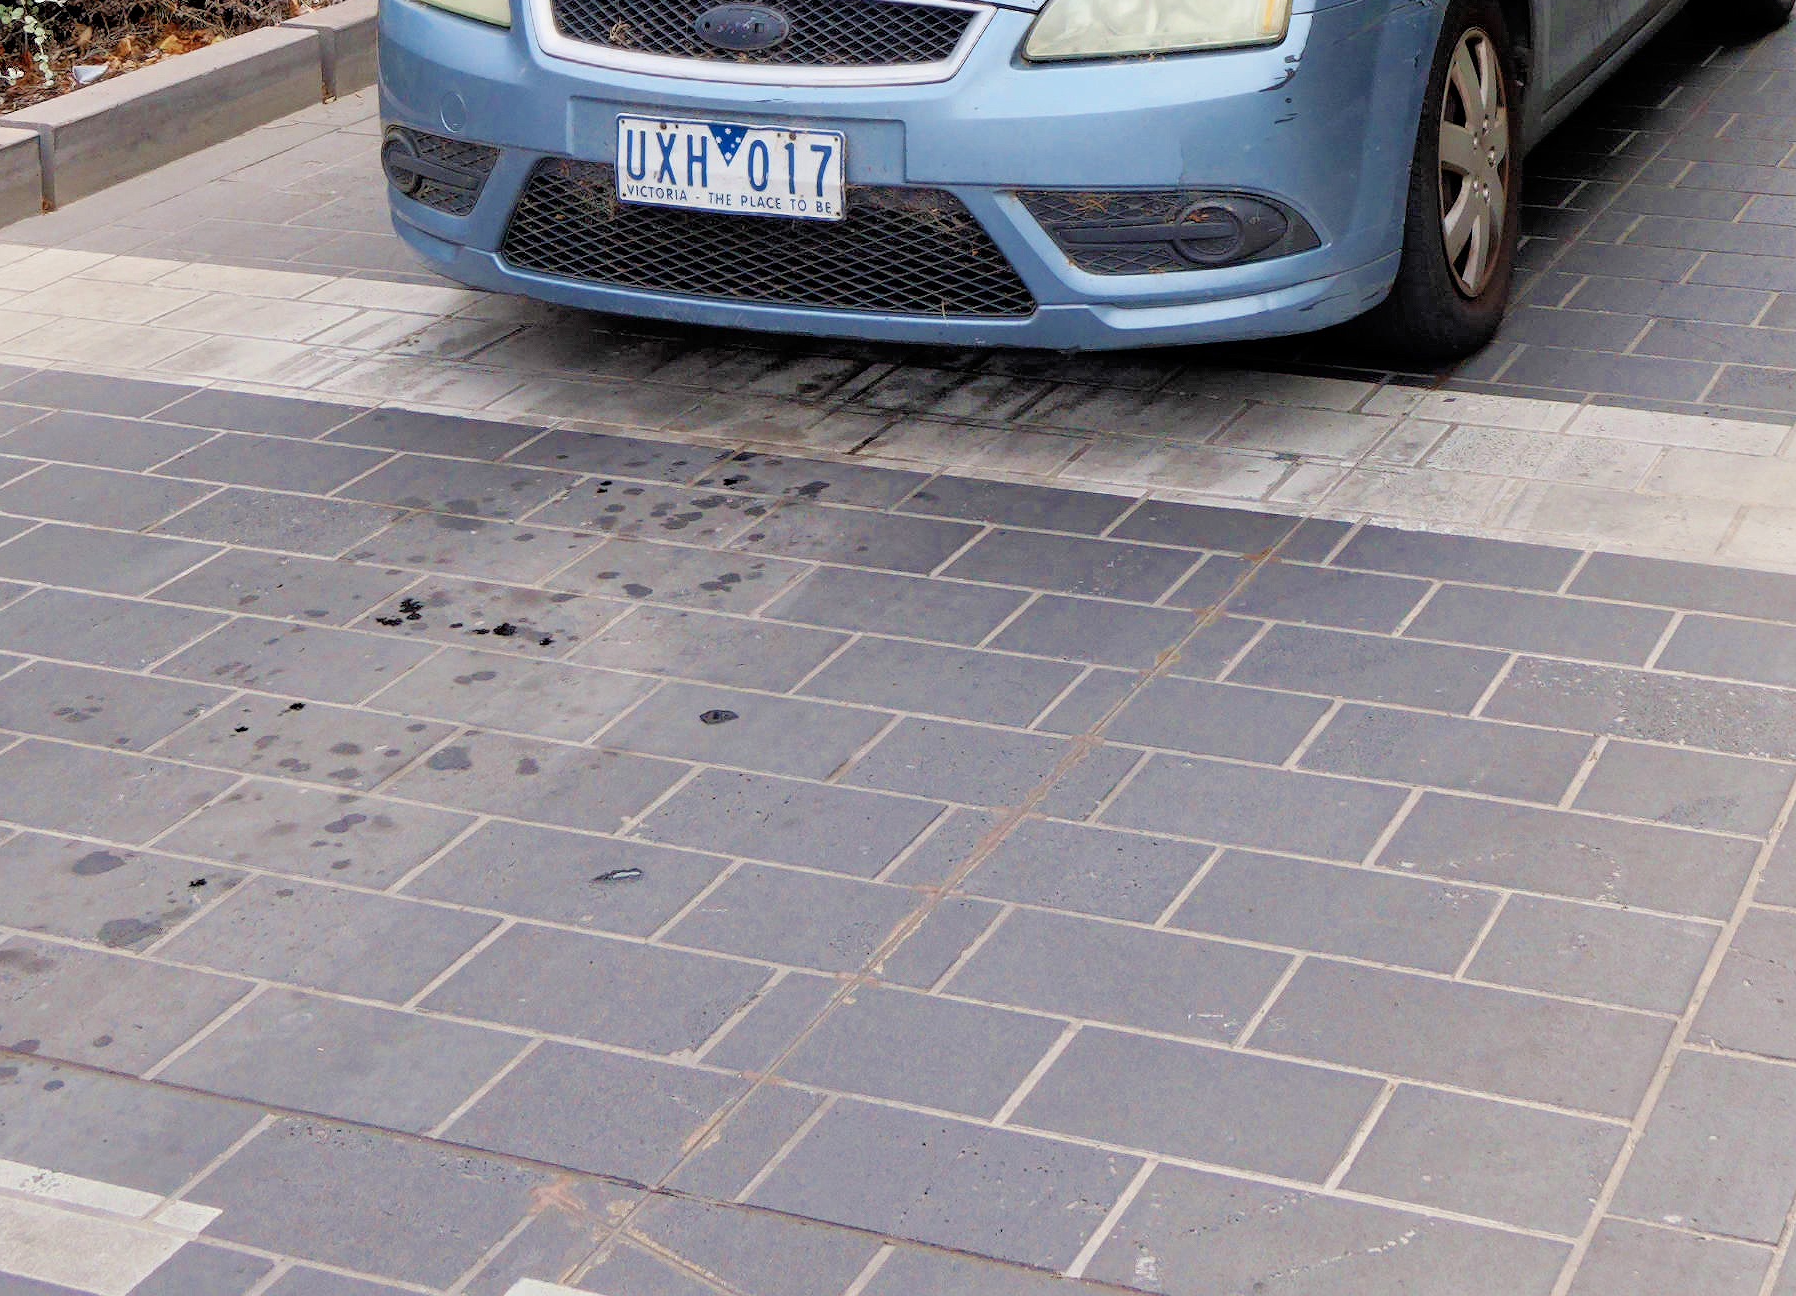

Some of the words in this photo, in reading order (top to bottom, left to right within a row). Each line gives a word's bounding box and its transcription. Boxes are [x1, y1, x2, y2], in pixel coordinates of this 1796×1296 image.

[626, 129, 708, 188] UXH
[747, 139, 833, 198] 017
[626, 183, 688, 202] VICTORIA
[708, 192, 733, 207] THE
[741, 194, 782, 210] PLACE
[790, 198, 807, 212] TO
[816, 200, 832, 215] BE
